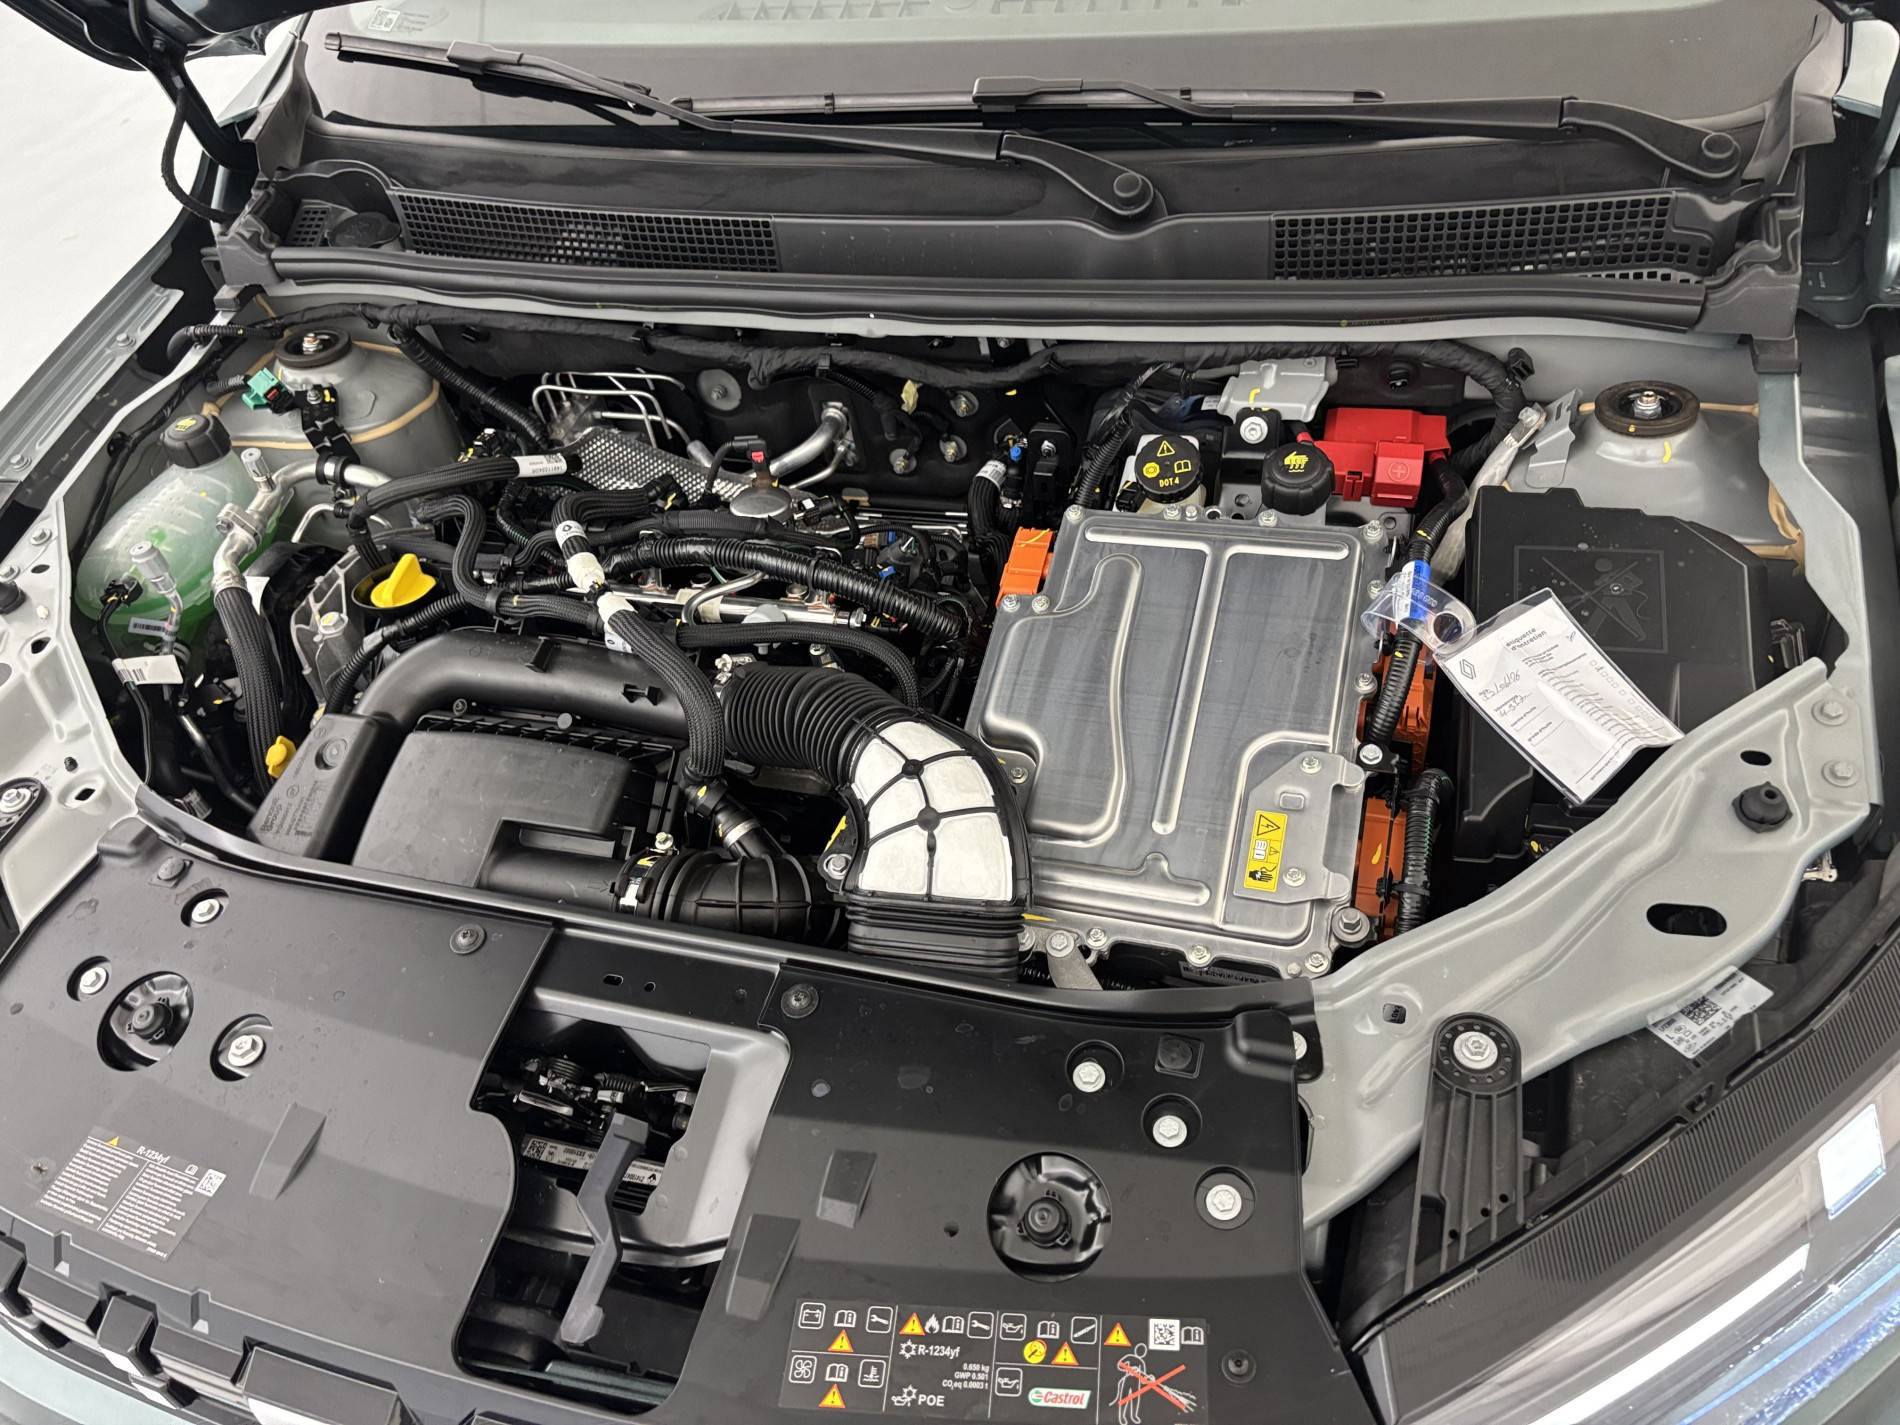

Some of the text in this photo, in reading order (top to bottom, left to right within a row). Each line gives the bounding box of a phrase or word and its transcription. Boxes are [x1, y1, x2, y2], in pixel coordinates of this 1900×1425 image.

[1159, 476, 1180, 488] DOT 4
[918, 1344, 960, 1359] R-1234yf
[981, 1364, 990, 1373] kg
[954, 1371, 971, 1379] GWP
[918, 1394, 945, 1407] POE
[1043, 1391, 1085, 1405] Castrol
